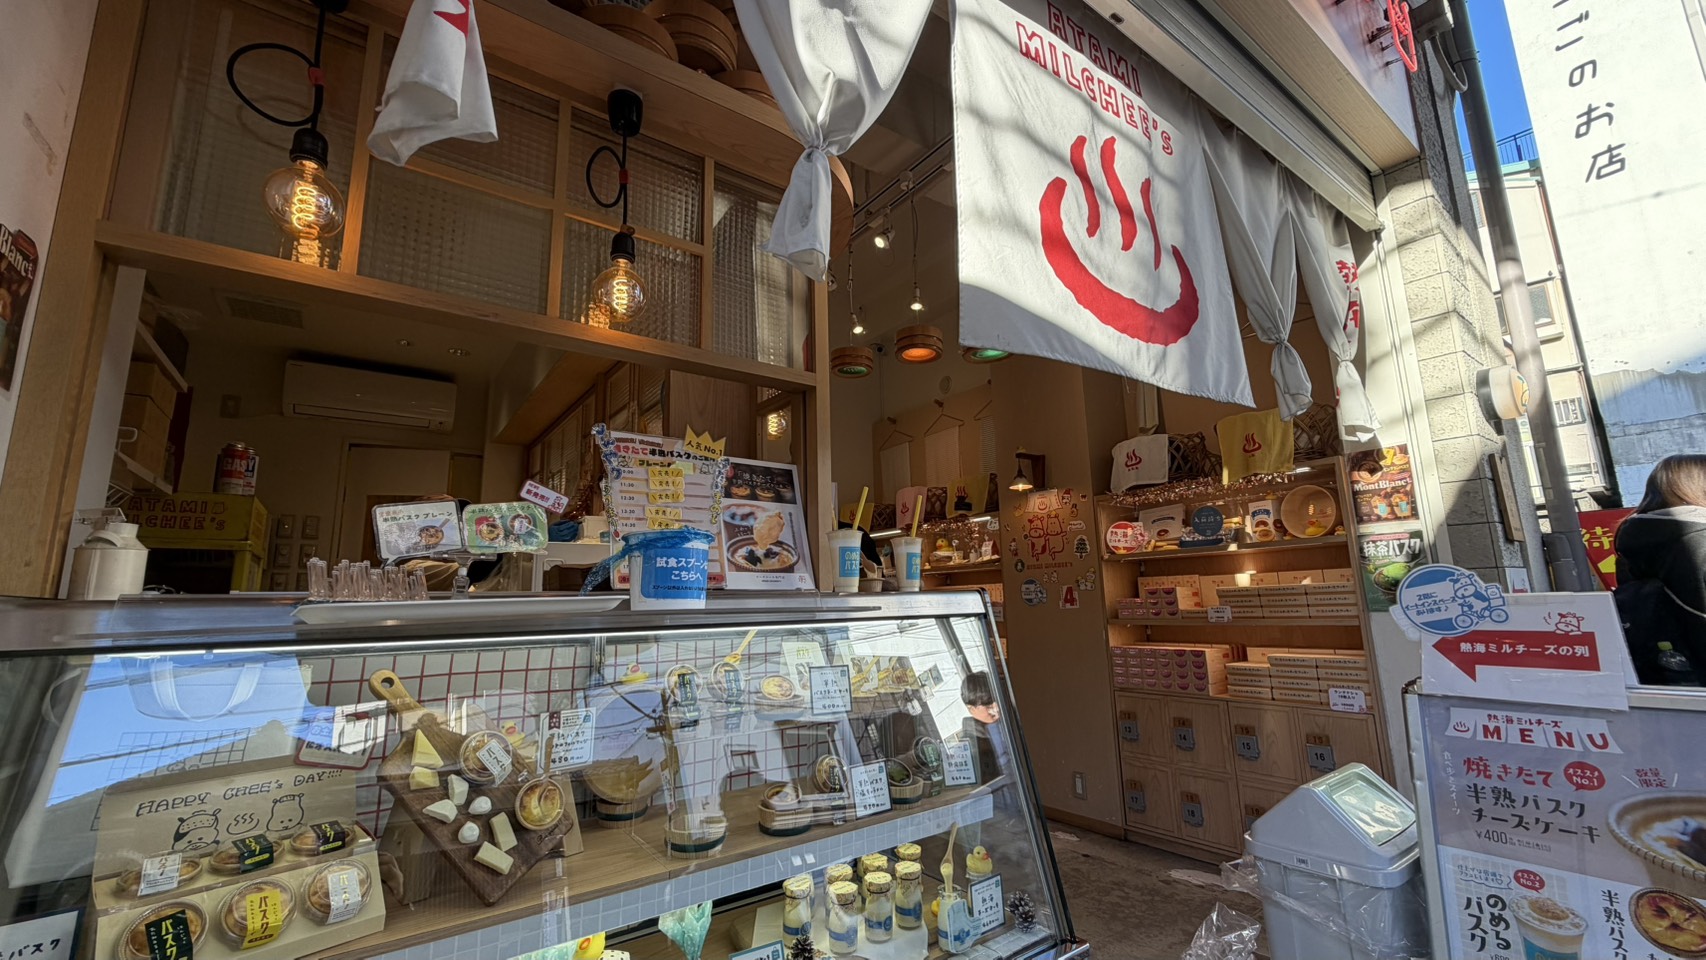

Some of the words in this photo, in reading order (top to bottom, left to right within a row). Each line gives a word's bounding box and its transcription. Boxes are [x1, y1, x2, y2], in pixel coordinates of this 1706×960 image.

[1047, 1, 1143, 98] ATAMI
[1015, 20, 1174, 156] MILCHEE'S
[1363, 538, 1421, 557] 抹茶バスク
[671, 570, 703, 581] こちらへ
[1404, 596, 1458, 612] イートインスペース
[1459, 642, 1590, 657] 熱海ミルチーズの列
[1486, 713, 1563, 729] 熱海ミルチーズ
[1178, 733, 1187, 741] 14
[1242, 741, 1251, 750] 15
[1481, 723, 1610, 751] MENU
[1314, 752, 1326, 761] 16
[1462, 755, 1554, 788] 焼きたて
[1572, 776, 1599, 787] No.1
[135, 792, 212, 817] HAPPY
[1465, 782, 1586, 818] 半熟バスク
[1471, 807, 1601, 844] チーズケーキ
[1475, 828, 1508, 845] ¥400
[1520, 878, 1540, 888] No.2
[258, 895, 270, 935] バスク
[1463, 896, 1489, 953] バスク
[1485, 893, 1512, 951] のめる
